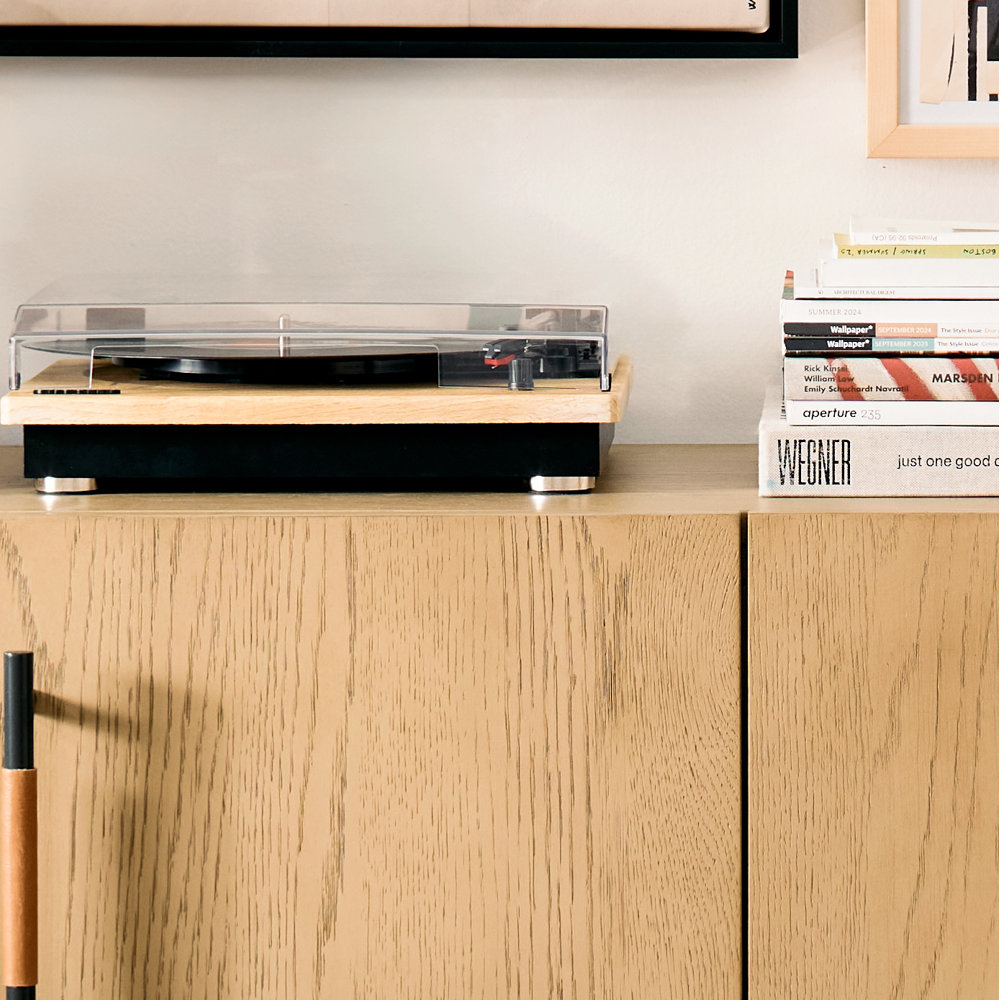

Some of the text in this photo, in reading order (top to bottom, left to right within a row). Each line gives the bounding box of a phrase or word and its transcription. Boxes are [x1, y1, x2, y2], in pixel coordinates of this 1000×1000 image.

[900, 248, 926, 256] SPRING
[963, 248, 997, 256] BOSTON
[932, 373, 993, 383] MARSDEN
[804, 385, 826, 394] Emily
[802, 408, 881, 420] aperture 235
[777, 439, 851, 485] WEGNER
[897, 454, 922, 470] just
[926, 457, 952, 467] one
[955, 454, 991, 470] good
